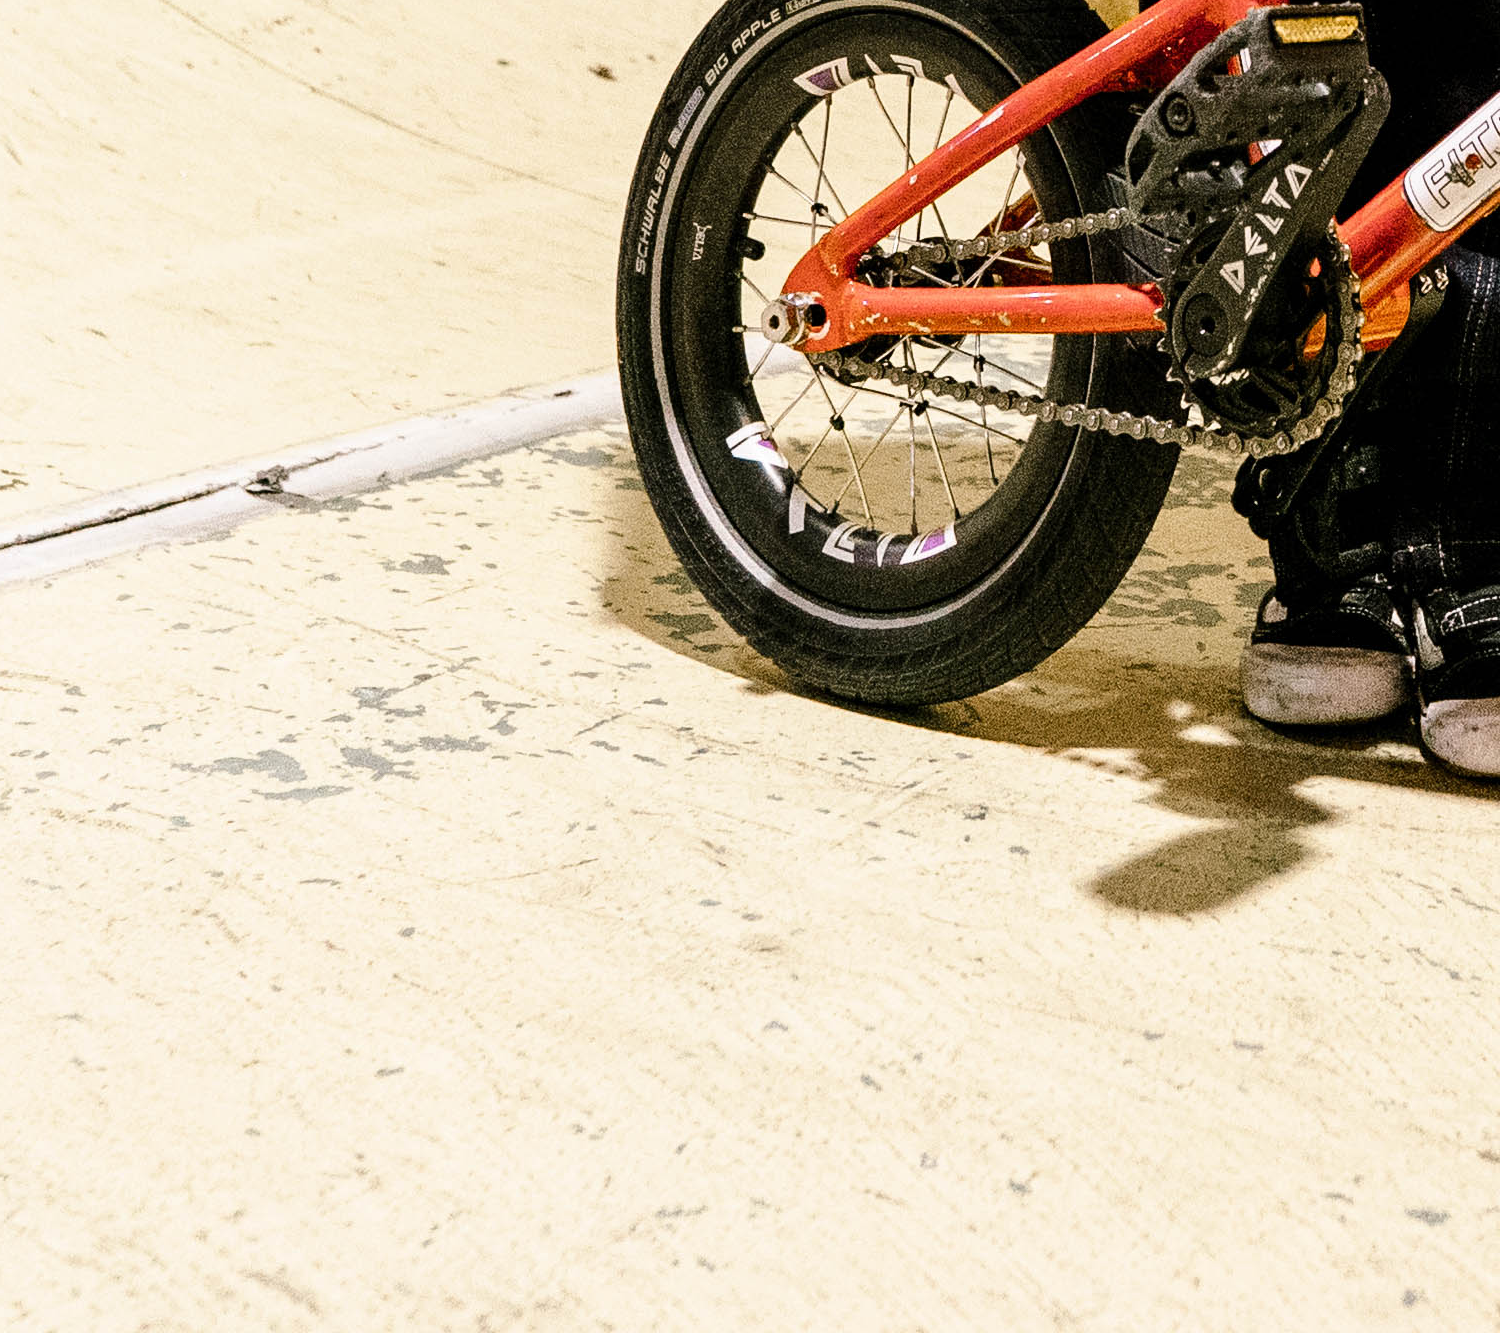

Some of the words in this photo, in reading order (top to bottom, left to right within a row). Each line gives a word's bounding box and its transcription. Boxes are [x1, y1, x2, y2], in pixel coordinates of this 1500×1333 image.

[704, 56, 730, 86] BIG
[732, 8, 781, 52] APPLE
[636, 154, 672, 276] SCHWALBE
[1220, 163, 1313, 295] DELTA
